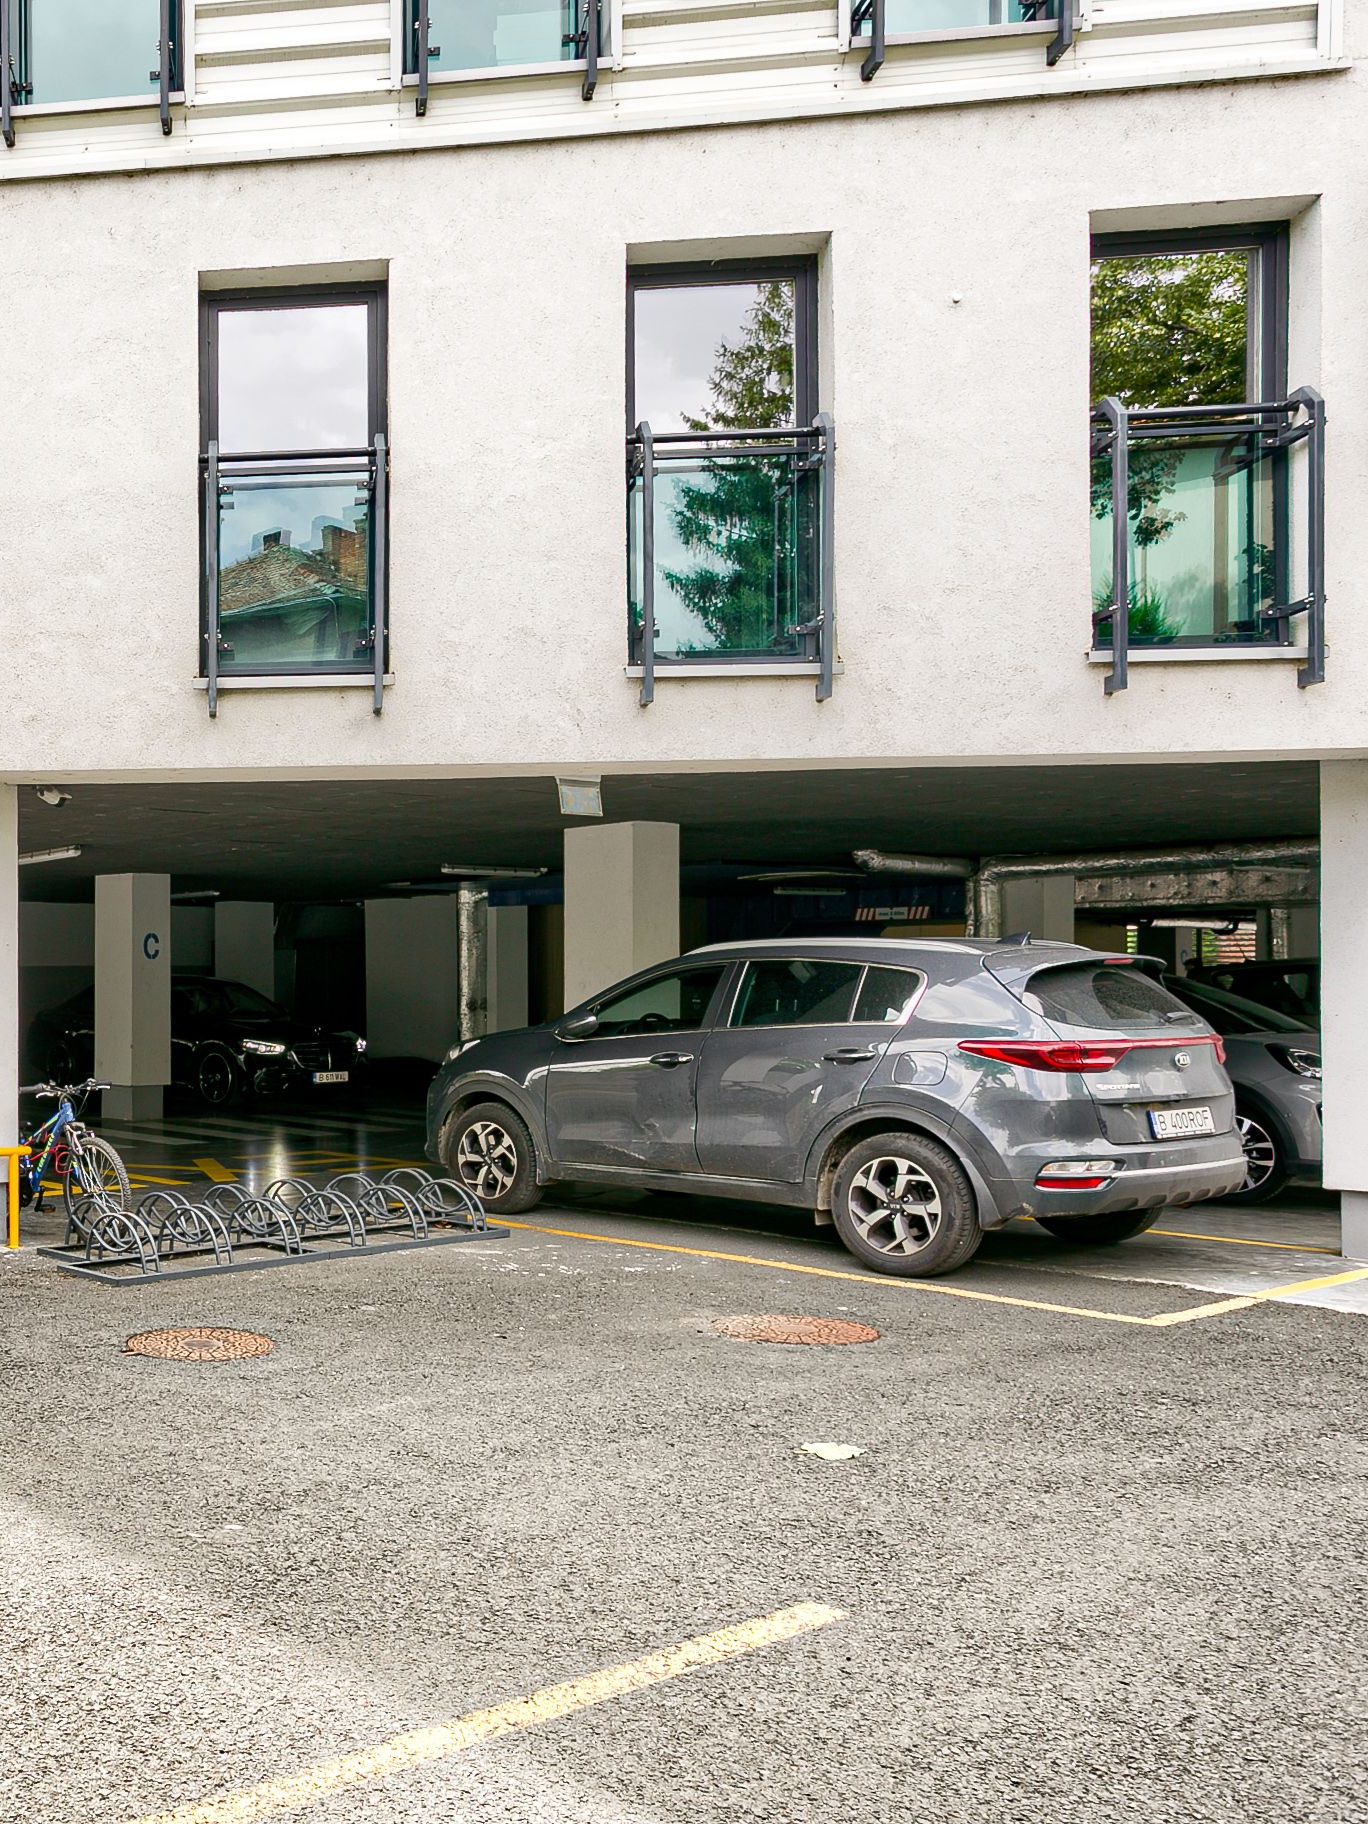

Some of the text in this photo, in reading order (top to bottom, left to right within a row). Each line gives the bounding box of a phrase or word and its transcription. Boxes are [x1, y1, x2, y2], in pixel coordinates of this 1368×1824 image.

[143, 932, 160, 960] C
[318, 1073, 324, 1081] B
[1158, 1114, 1167, 1131] B
